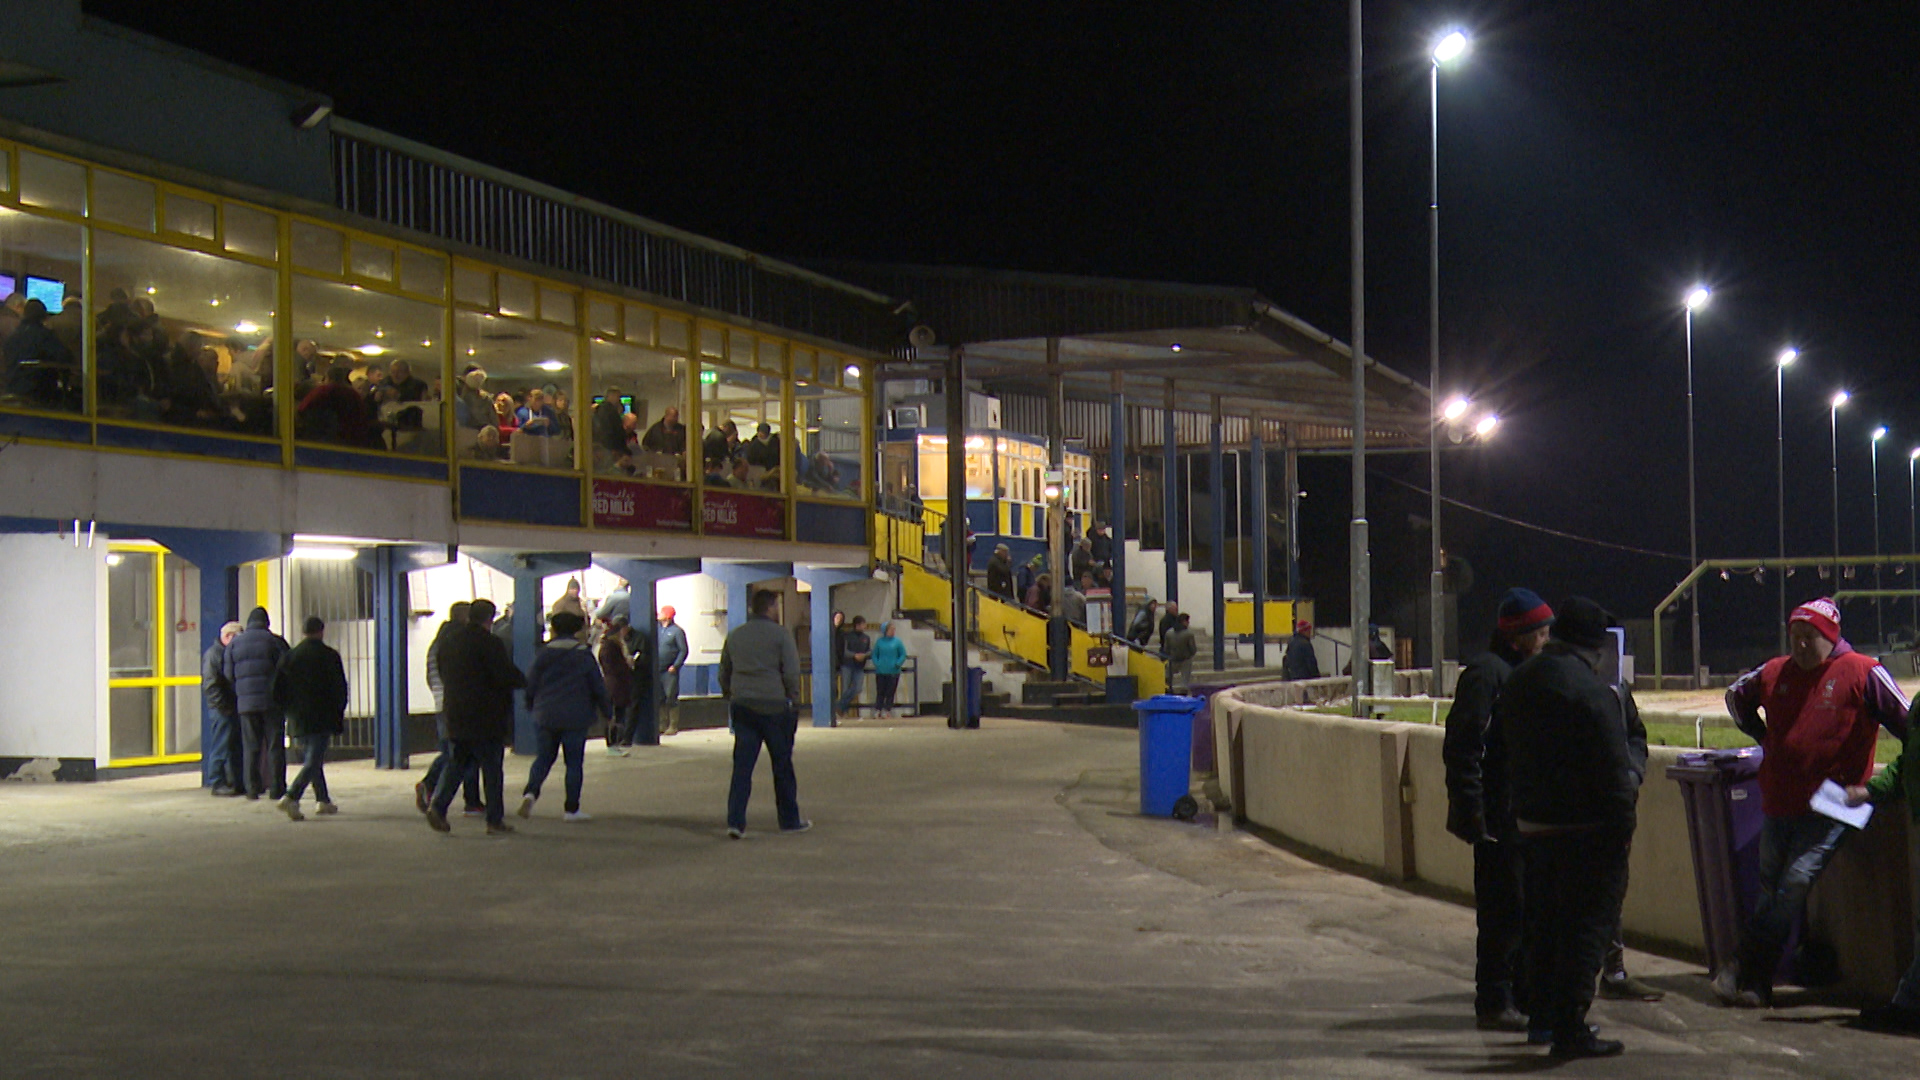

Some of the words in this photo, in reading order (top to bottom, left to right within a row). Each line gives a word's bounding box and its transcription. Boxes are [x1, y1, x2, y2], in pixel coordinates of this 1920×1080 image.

[593, 499, 609, 514] RED
[609, 499, 635, 516] MILLS
[717, 509, 737, 524] MILLS
